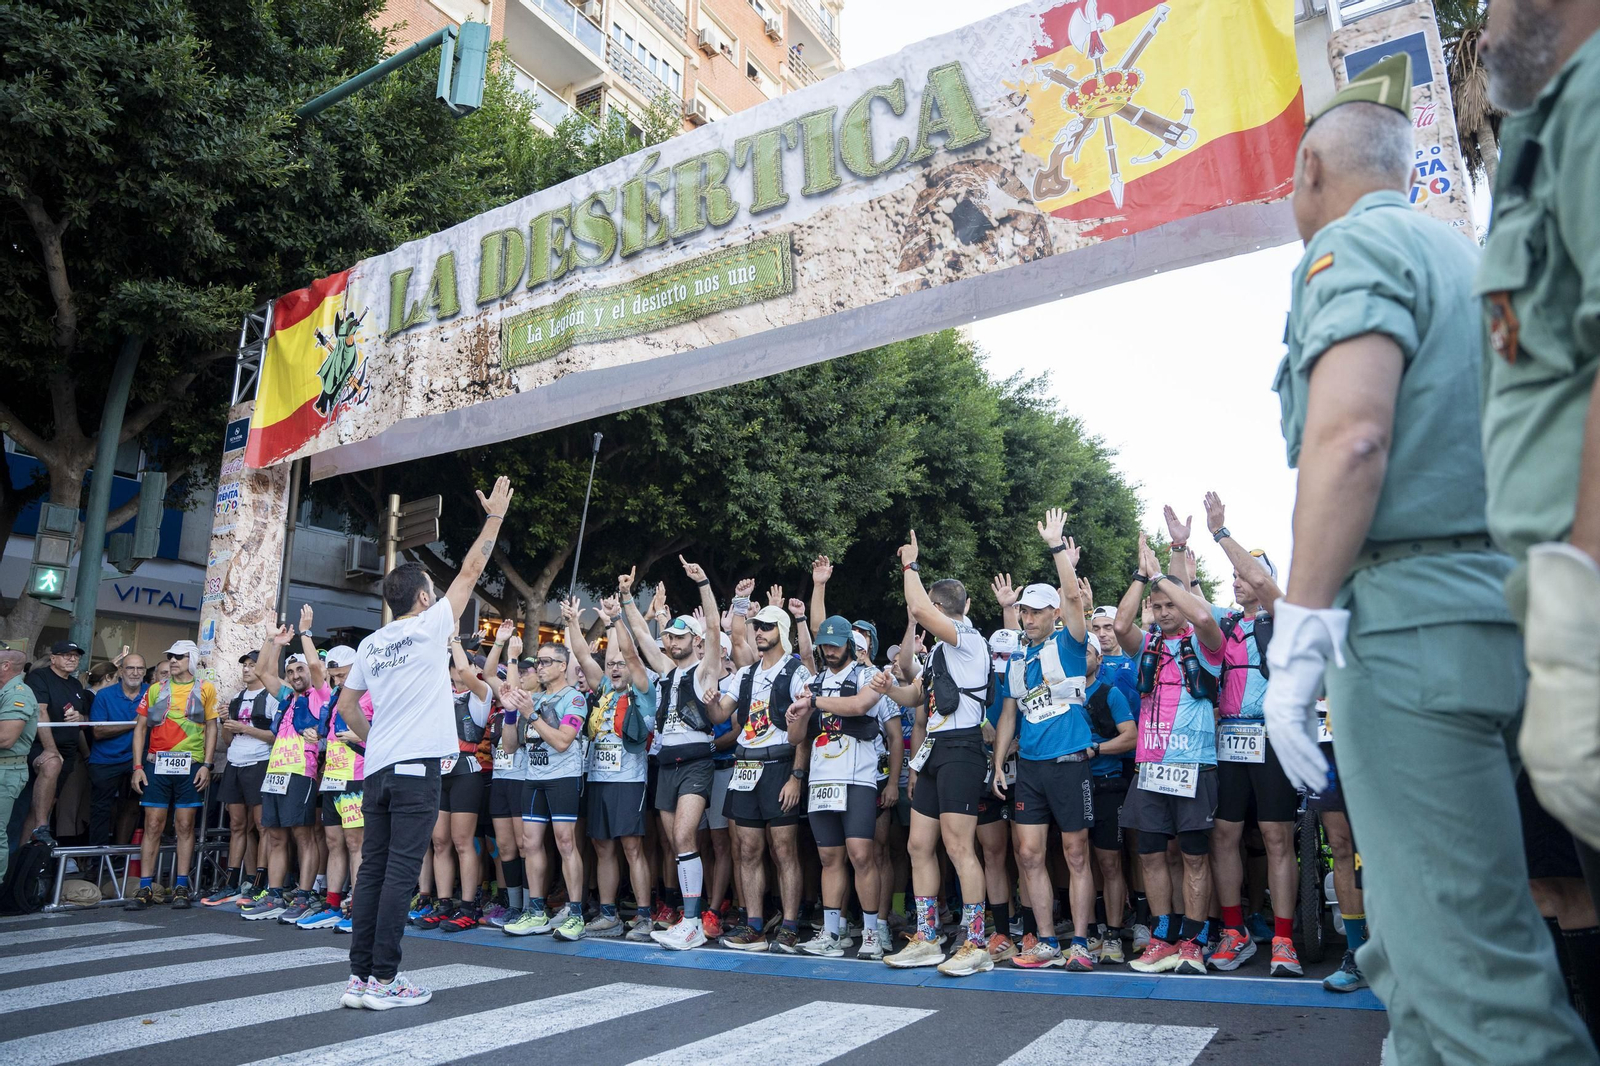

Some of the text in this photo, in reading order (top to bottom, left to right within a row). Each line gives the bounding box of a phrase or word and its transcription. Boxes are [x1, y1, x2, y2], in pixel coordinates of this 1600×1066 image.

[386, 60, 992, 338] LA DESÉRTICA
[527, 264, 756, 344] La Legión y el desierto nos une
[217, 490, 239, 502] RENTA
[216, 500, 238, 513] TODO
[114, 583, 203, 612] VITAL
[1144, 733, 1189, 750] VIATOR
[1227, 736, 1256, 749] 1776
[165, 759, 187, 767] 1480
[270, 755, 301, 769] VALLE
[738, 769, 757, 781] 4601
[1156, 766, 1189, 783] 2102
[816, 787, 840, 800] 4600
